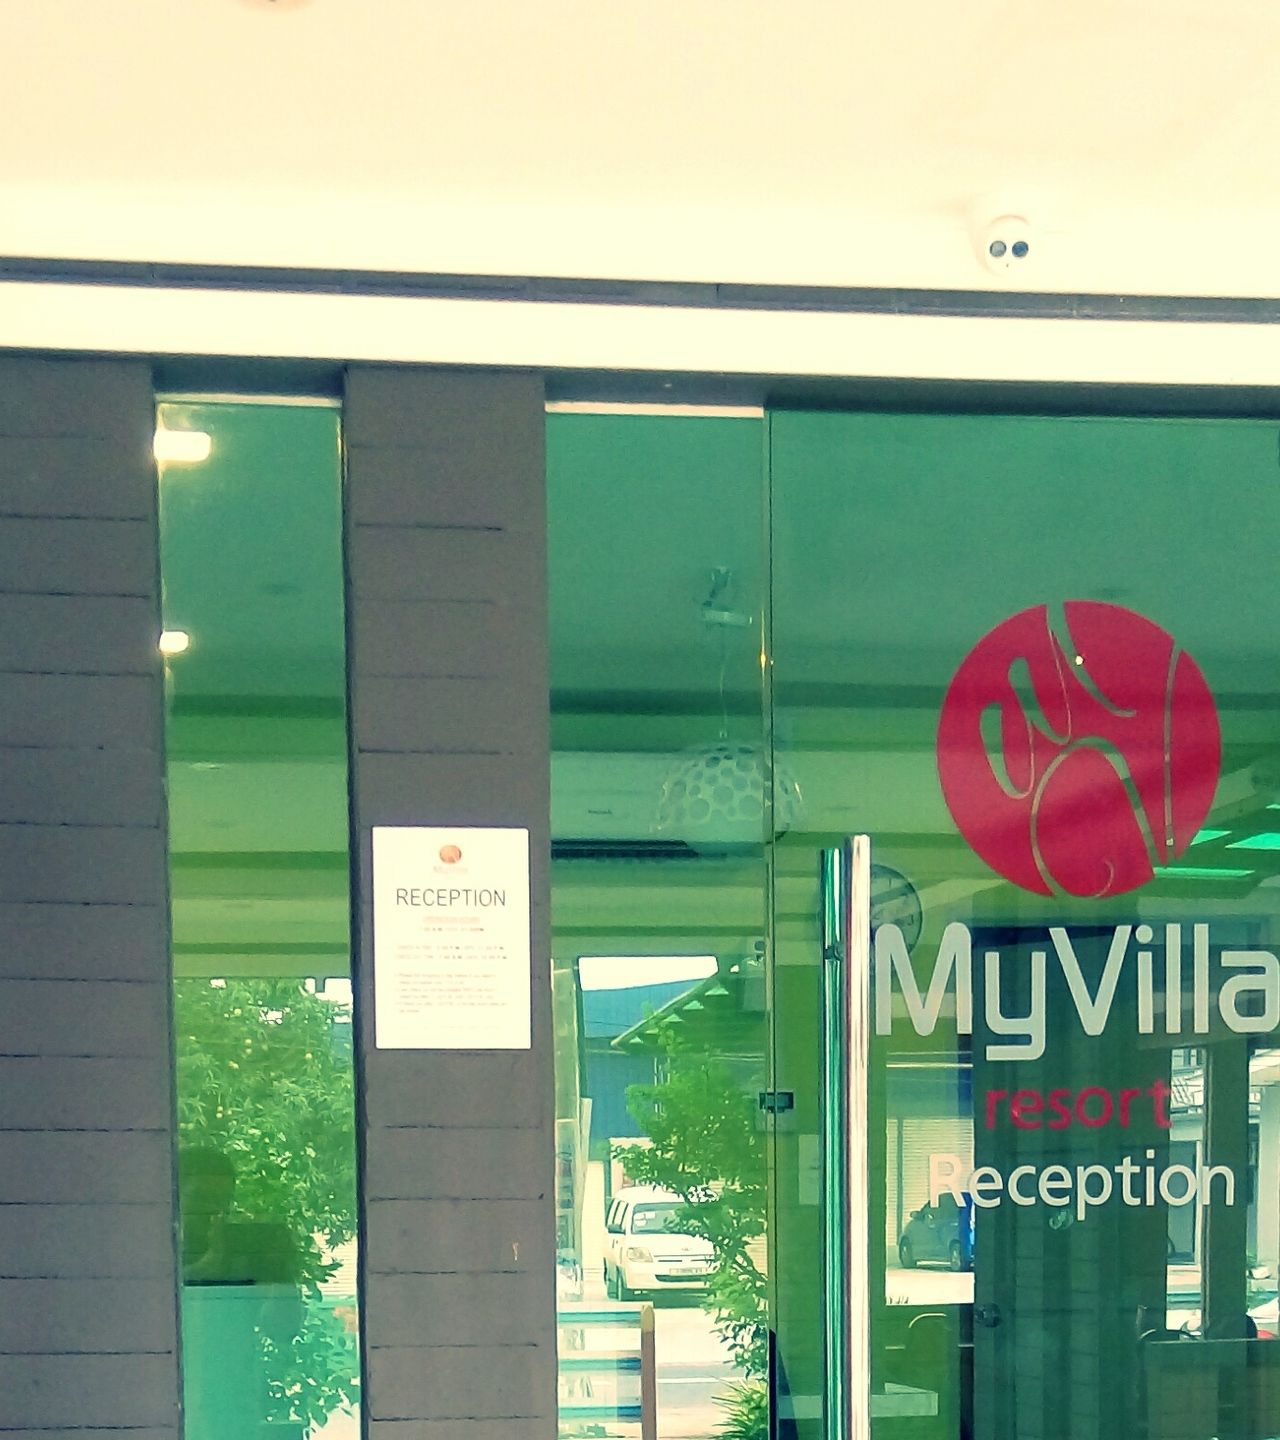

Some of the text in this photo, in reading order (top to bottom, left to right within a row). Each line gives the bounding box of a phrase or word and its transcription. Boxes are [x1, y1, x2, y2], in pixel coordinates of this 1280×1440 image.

[396, 888, 506, 907] RECEPTION
[875, 922, 1280, 1061] MyVilla
[984, 1078, 1173, 1130] resort
[928, 1149, 1235, 1221] Reception
